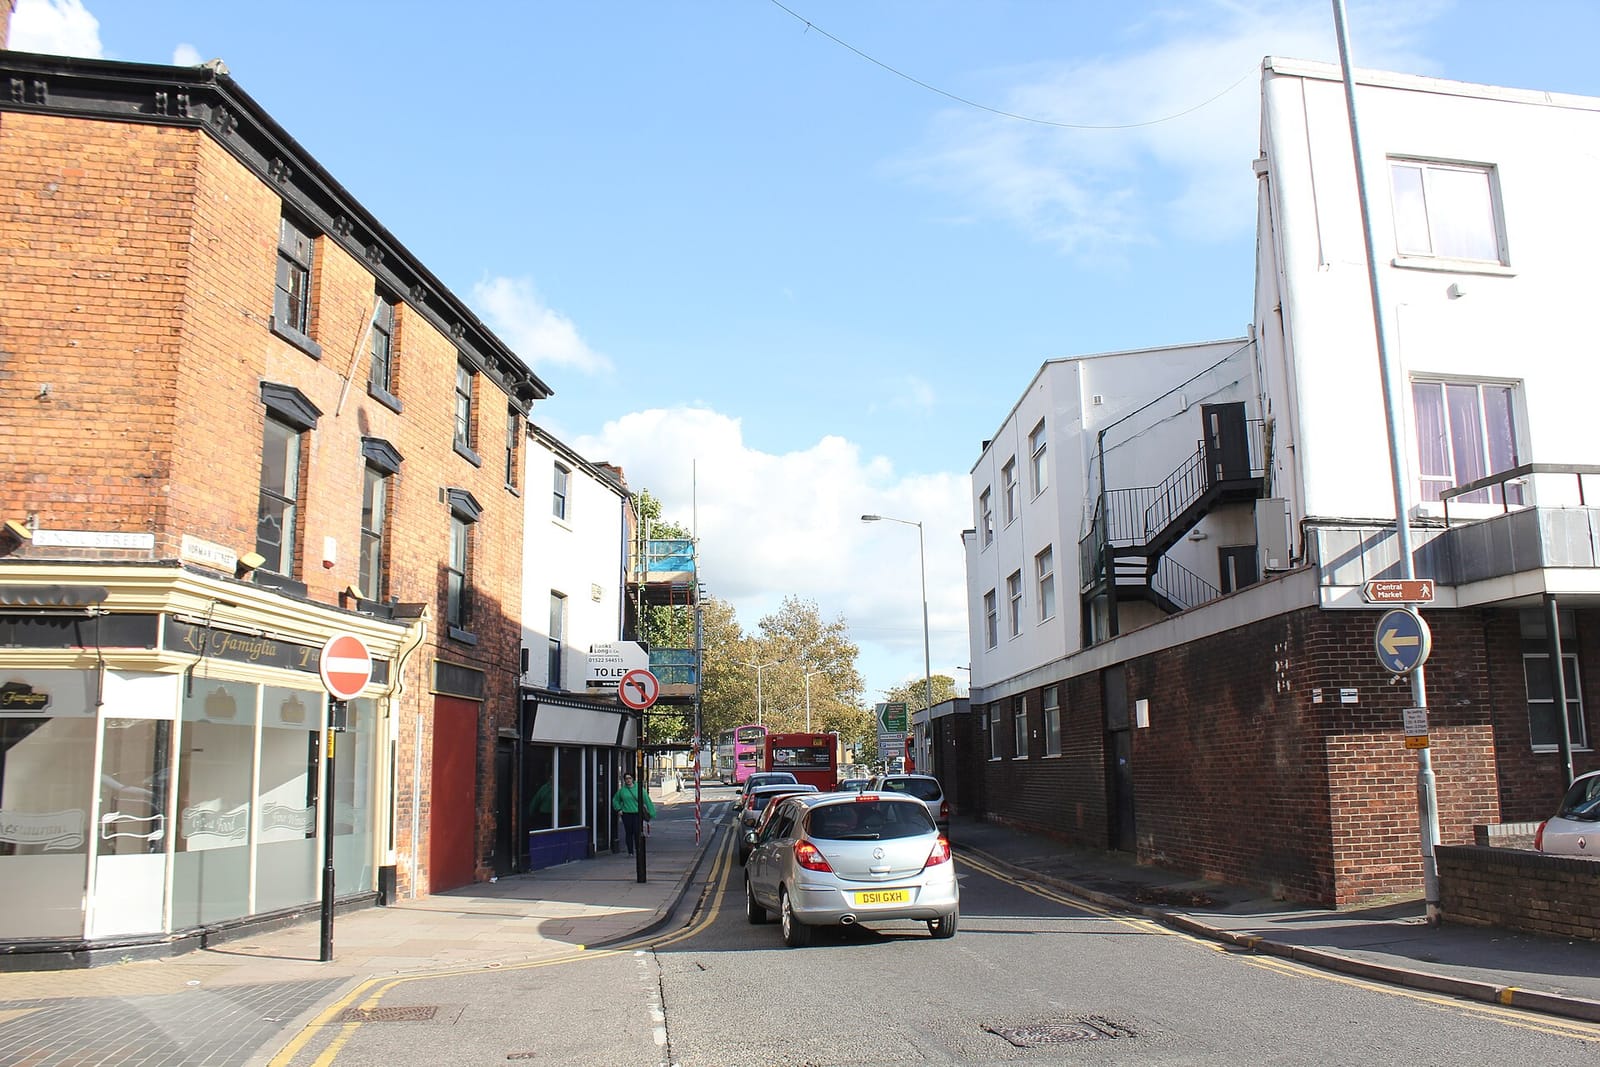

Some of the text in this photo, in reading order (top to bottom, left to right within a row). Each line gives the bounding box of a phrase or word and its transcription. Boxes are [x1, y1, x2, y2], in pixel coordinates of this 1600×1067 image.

[95, 533, 147, 547] STREET
[1376, 583, 1403, 591] Central
[211, 630, 277, 660] Famiglia
[594, 668, 629, 677] TO LET
[863, 892, 903, 904] DS11 GXH
